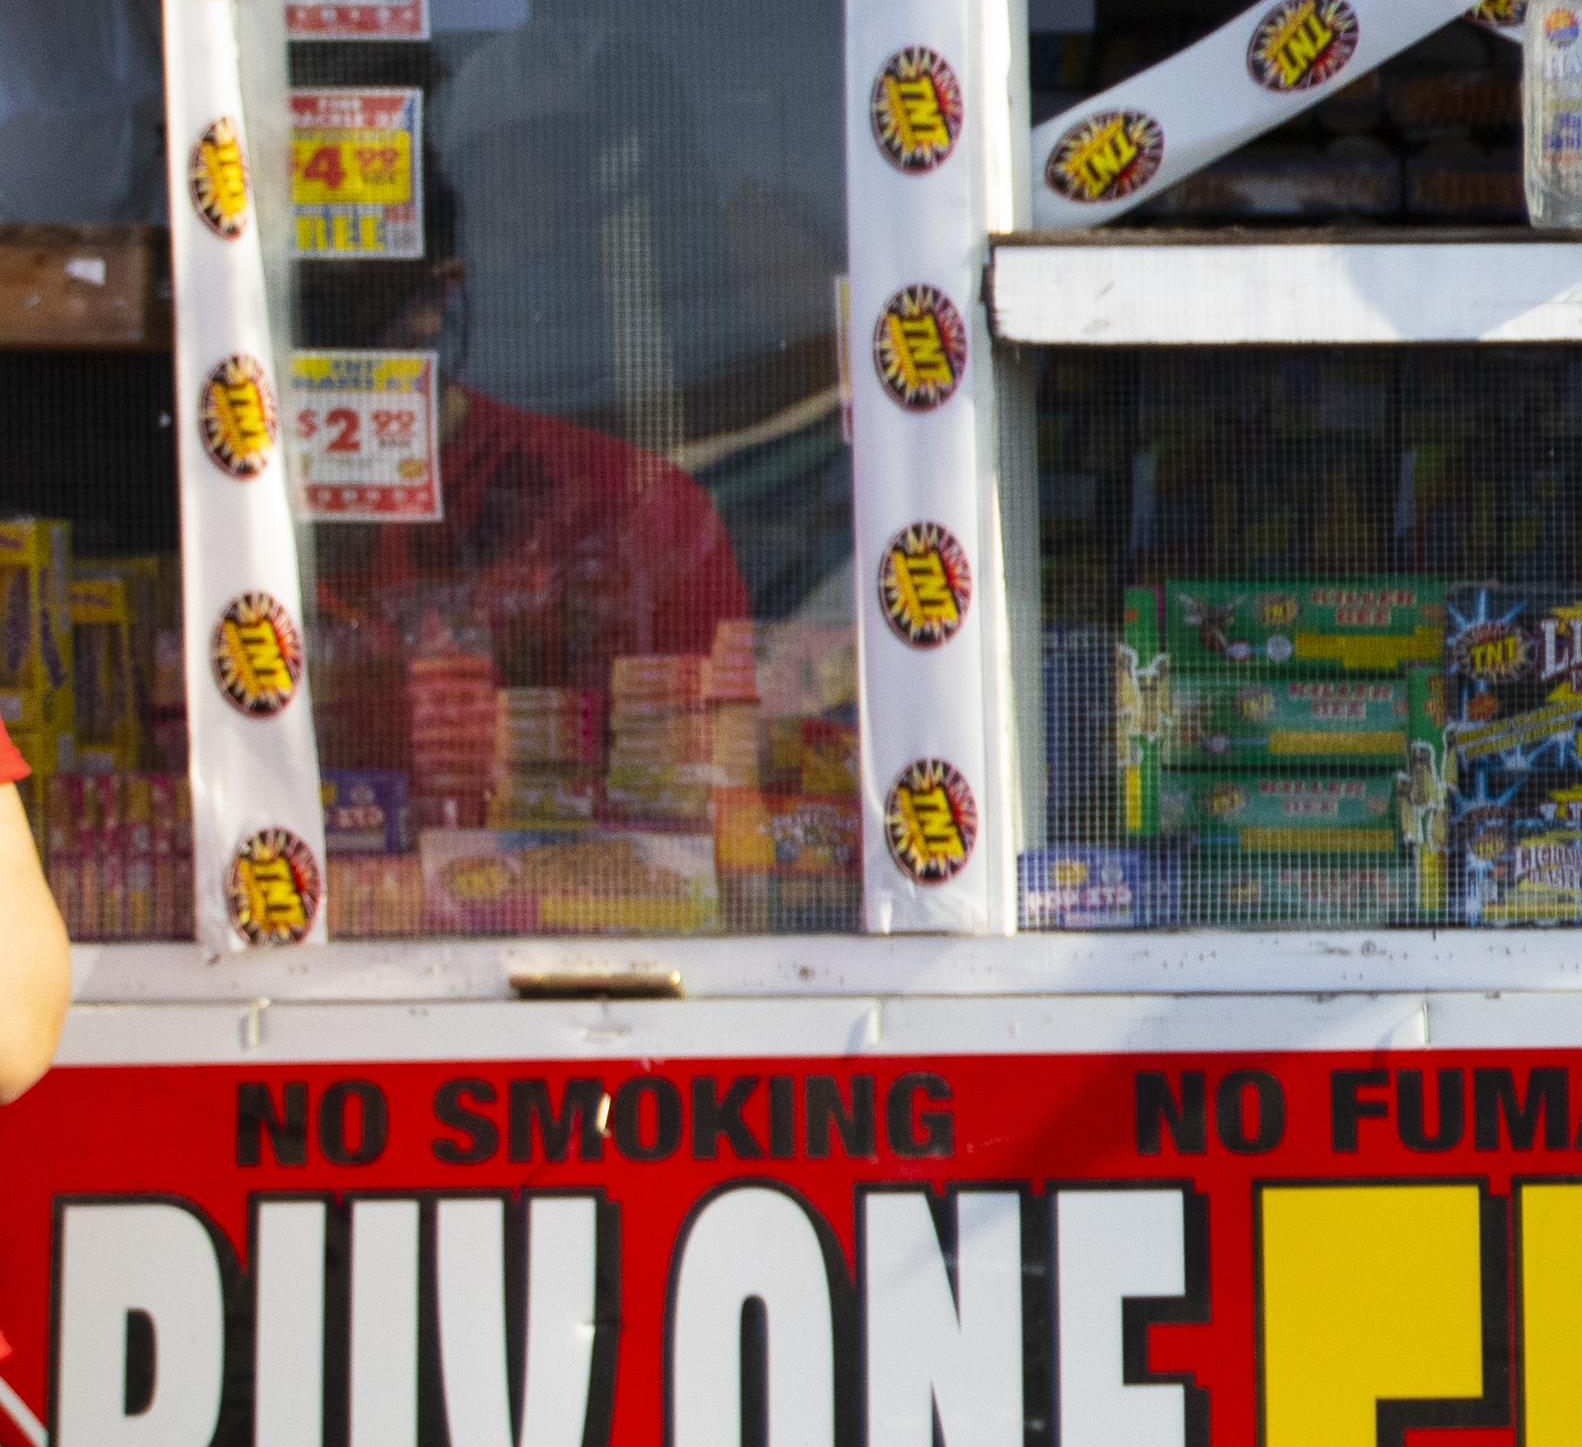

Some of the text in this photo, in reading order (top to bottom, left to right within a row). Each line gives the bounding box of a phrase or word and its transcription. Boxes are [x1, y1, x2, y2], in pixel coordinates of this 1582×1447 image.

[1469, 635, 1516, 673] TNT
[236, 1080, 390, 1167] NO
[429, 1071, 957, 1165] SMOKING
[1135, 1070, 1289, 1157] NO
